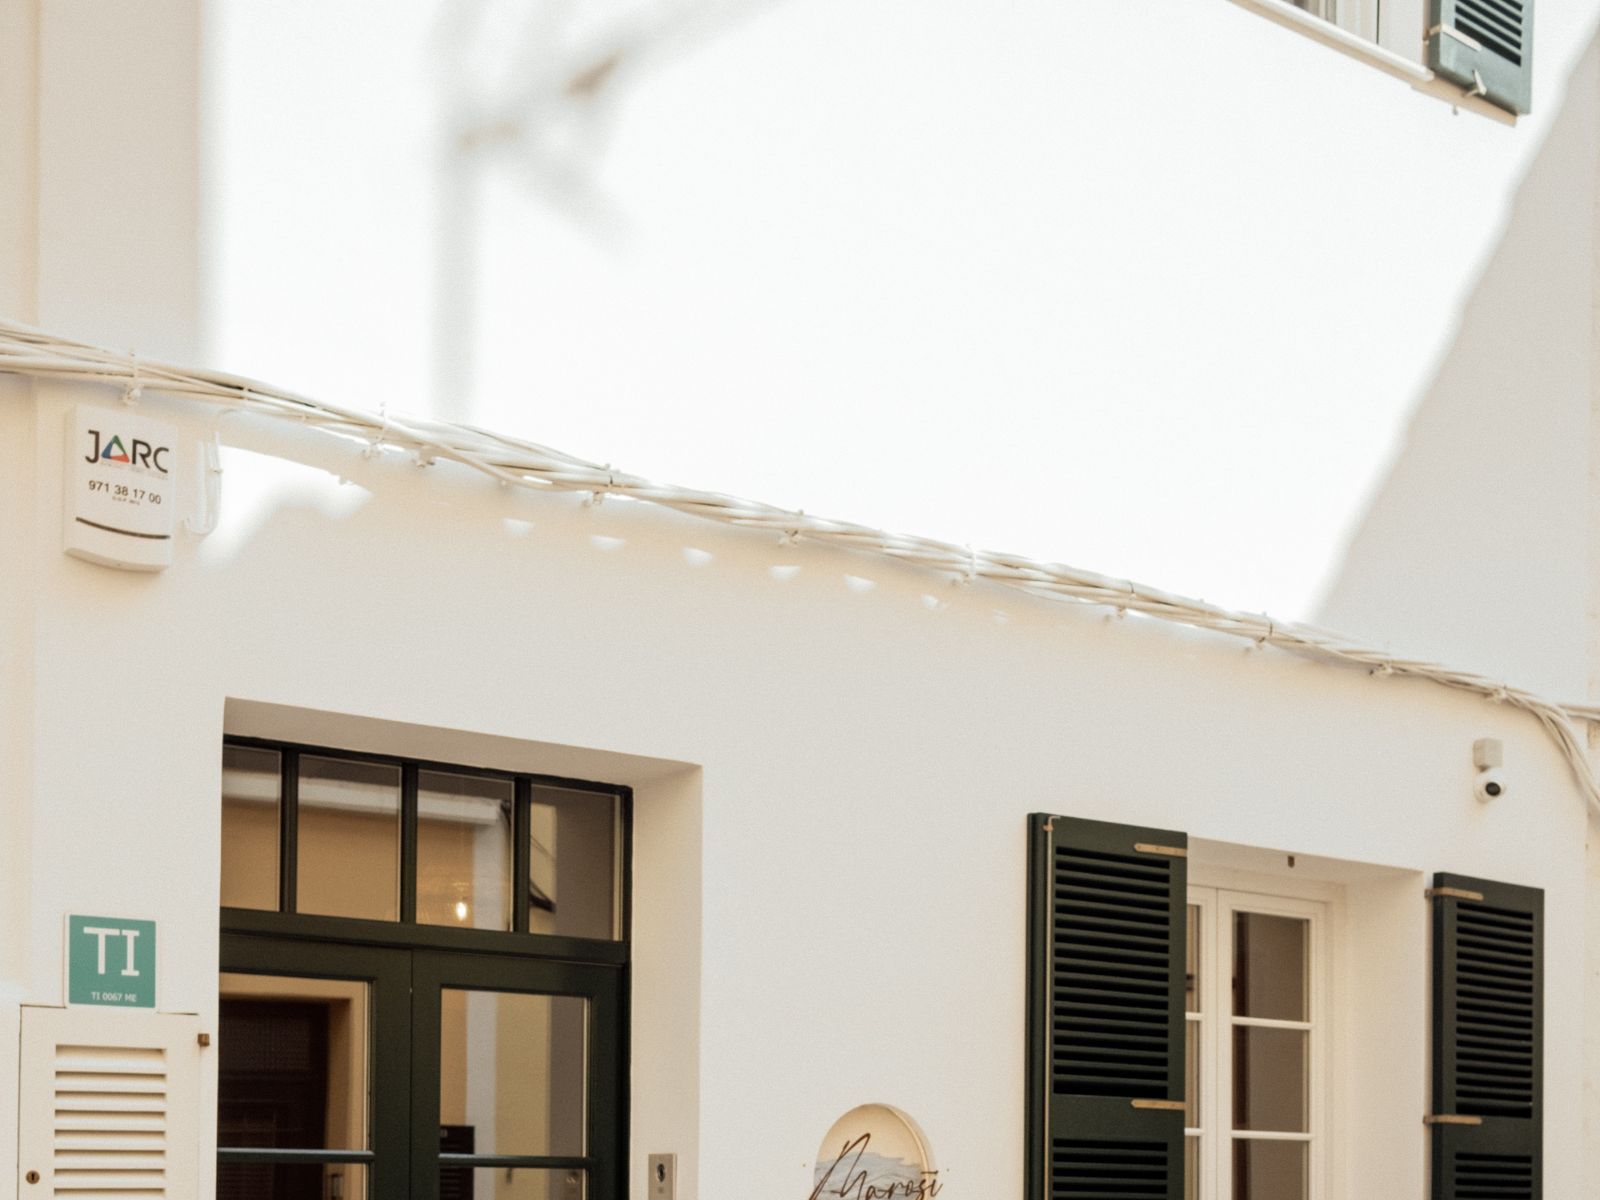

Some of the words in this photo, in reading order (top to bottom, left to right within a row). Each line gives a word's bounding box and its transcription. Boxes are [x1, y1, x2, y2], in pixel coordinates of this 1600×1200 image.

[84, 428, 170, 474] JARC
[88, 480, 109, 493] 971
[114, 484, 129, 497] 38
[133, 488, 146, 500] 17
[148, 492, 162, 505] 00
[83, 926, 140, 977] TI
[91, 991, 100, 1001] TI
[124, 993, 137, 1003] ME
